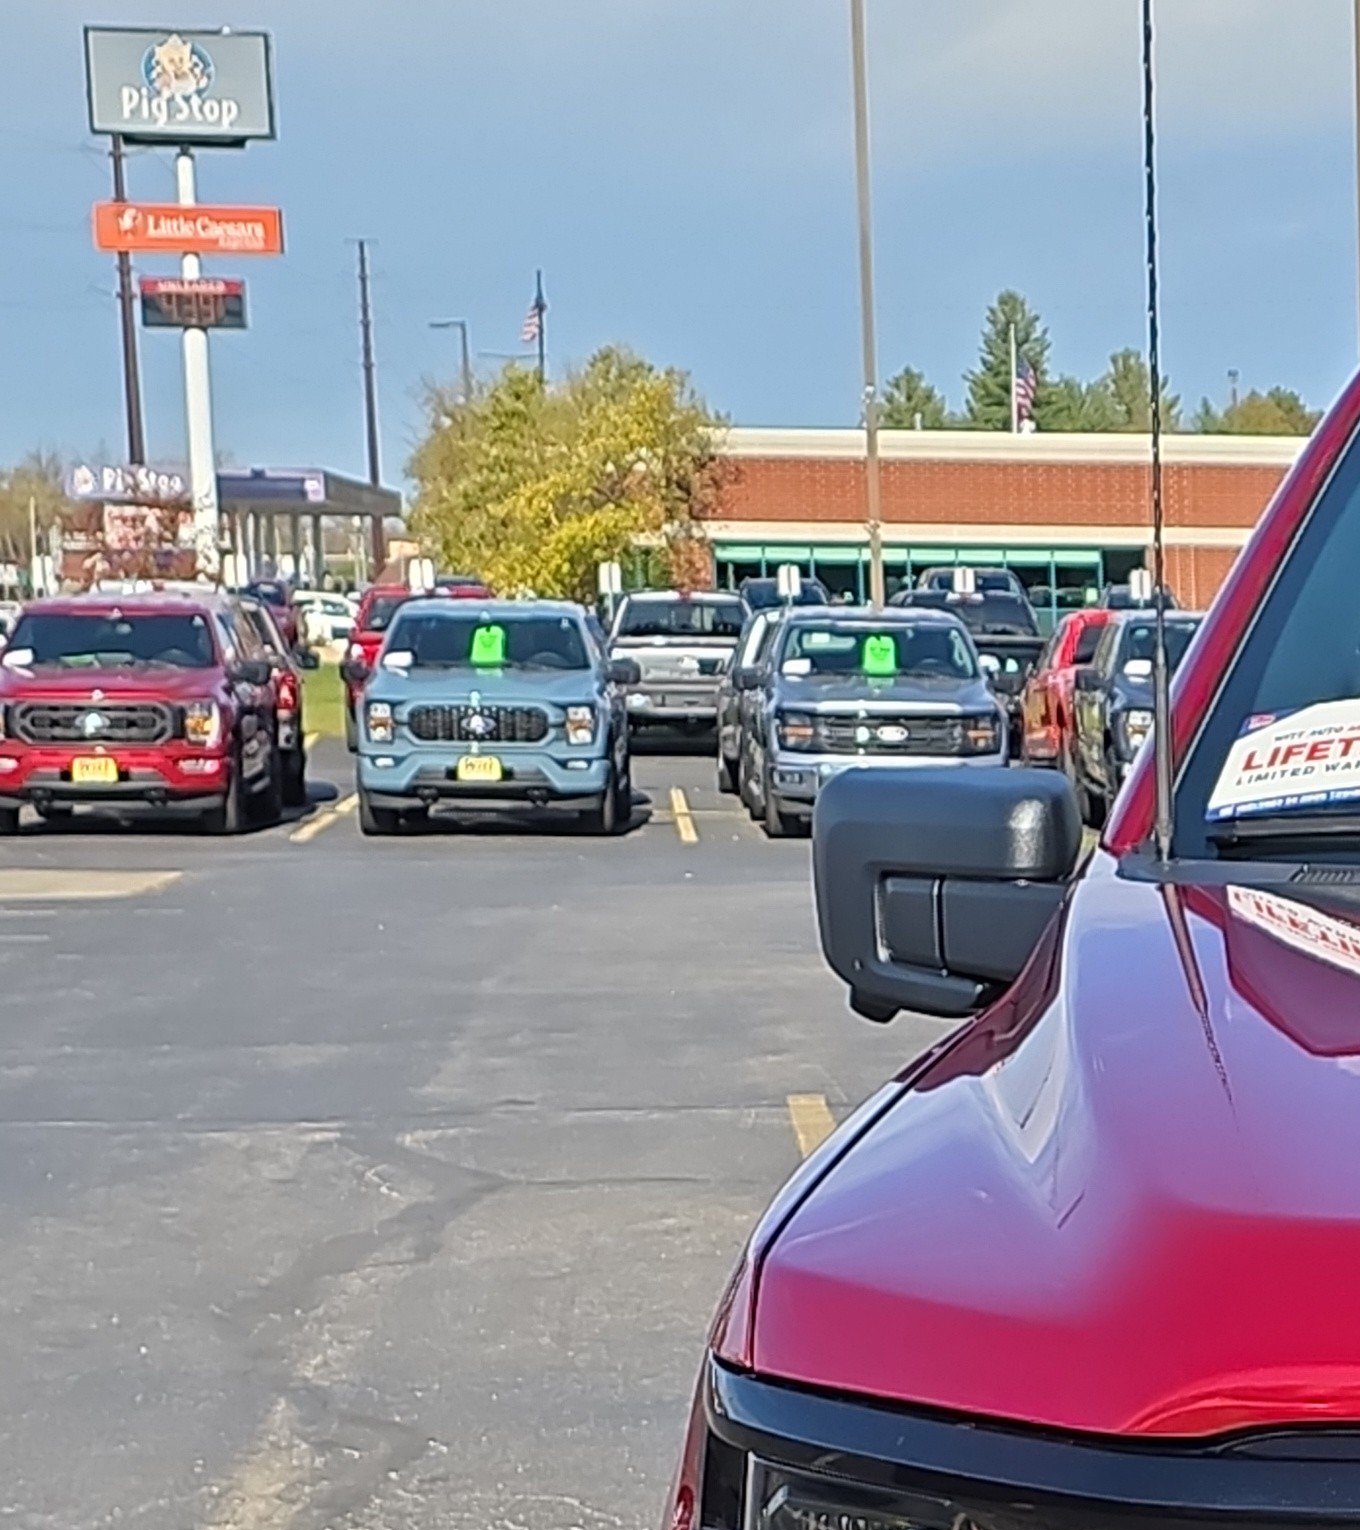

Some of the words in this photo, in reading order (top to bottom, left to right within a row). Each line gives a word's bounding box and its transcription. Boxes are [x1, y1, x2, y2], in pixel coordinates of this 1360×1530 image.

[121, 86, 168, 127] Pig
[173, 93, 238, 128] Stop
[147, 214, 194, 237] Little
[196, 216, 265, 239] Caesars
[1235, 765, 1315, 786] LIMITED
